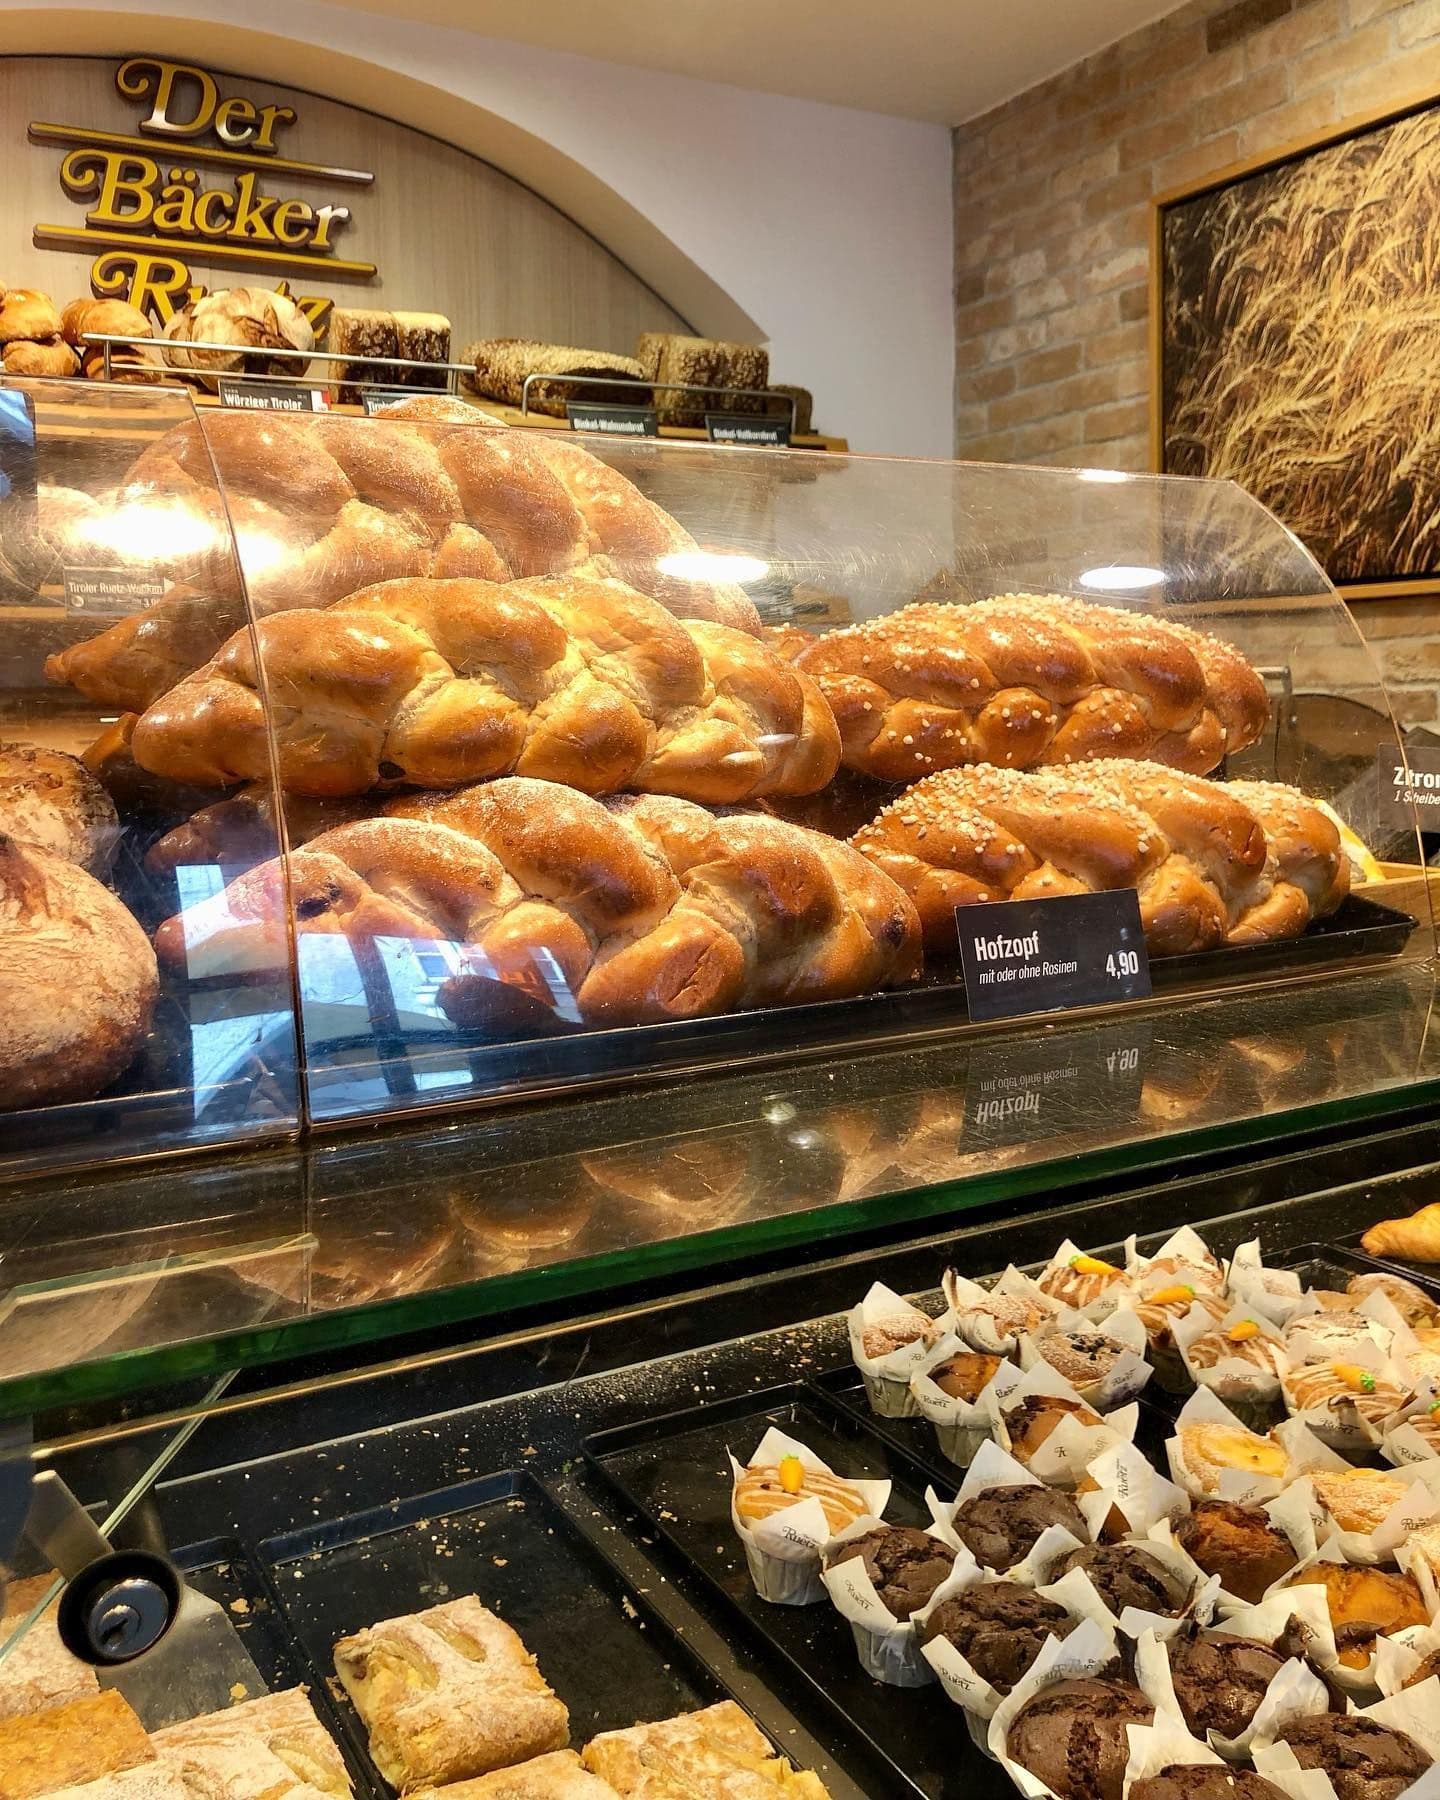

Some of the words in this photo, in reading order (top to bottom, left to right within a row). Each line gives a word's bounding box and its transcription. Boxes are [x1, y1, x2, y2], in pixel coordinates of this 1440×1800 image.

[115, 58, 297, 153] Der
[60, 149, 350, 252] Bäcker
[224, 393, 269, 408] Würziger
[270, 396, 302, 410] Tiroler
[1394, 789, 1401, 802] 1
[974, 930, 1039, 961] Hofzopf
[979, 968, 995, 985] mit
[996, 966, 1018, 982] oder
[1018, 964, 1041, 980] ohne
[1042, 960, 1077, 976] Rosinen
[1105, 950, 1139, 980] 4,90
[782, 1525, 817, 1549] Ruetz
[936, 1664, 970, 1691] Ruetz
